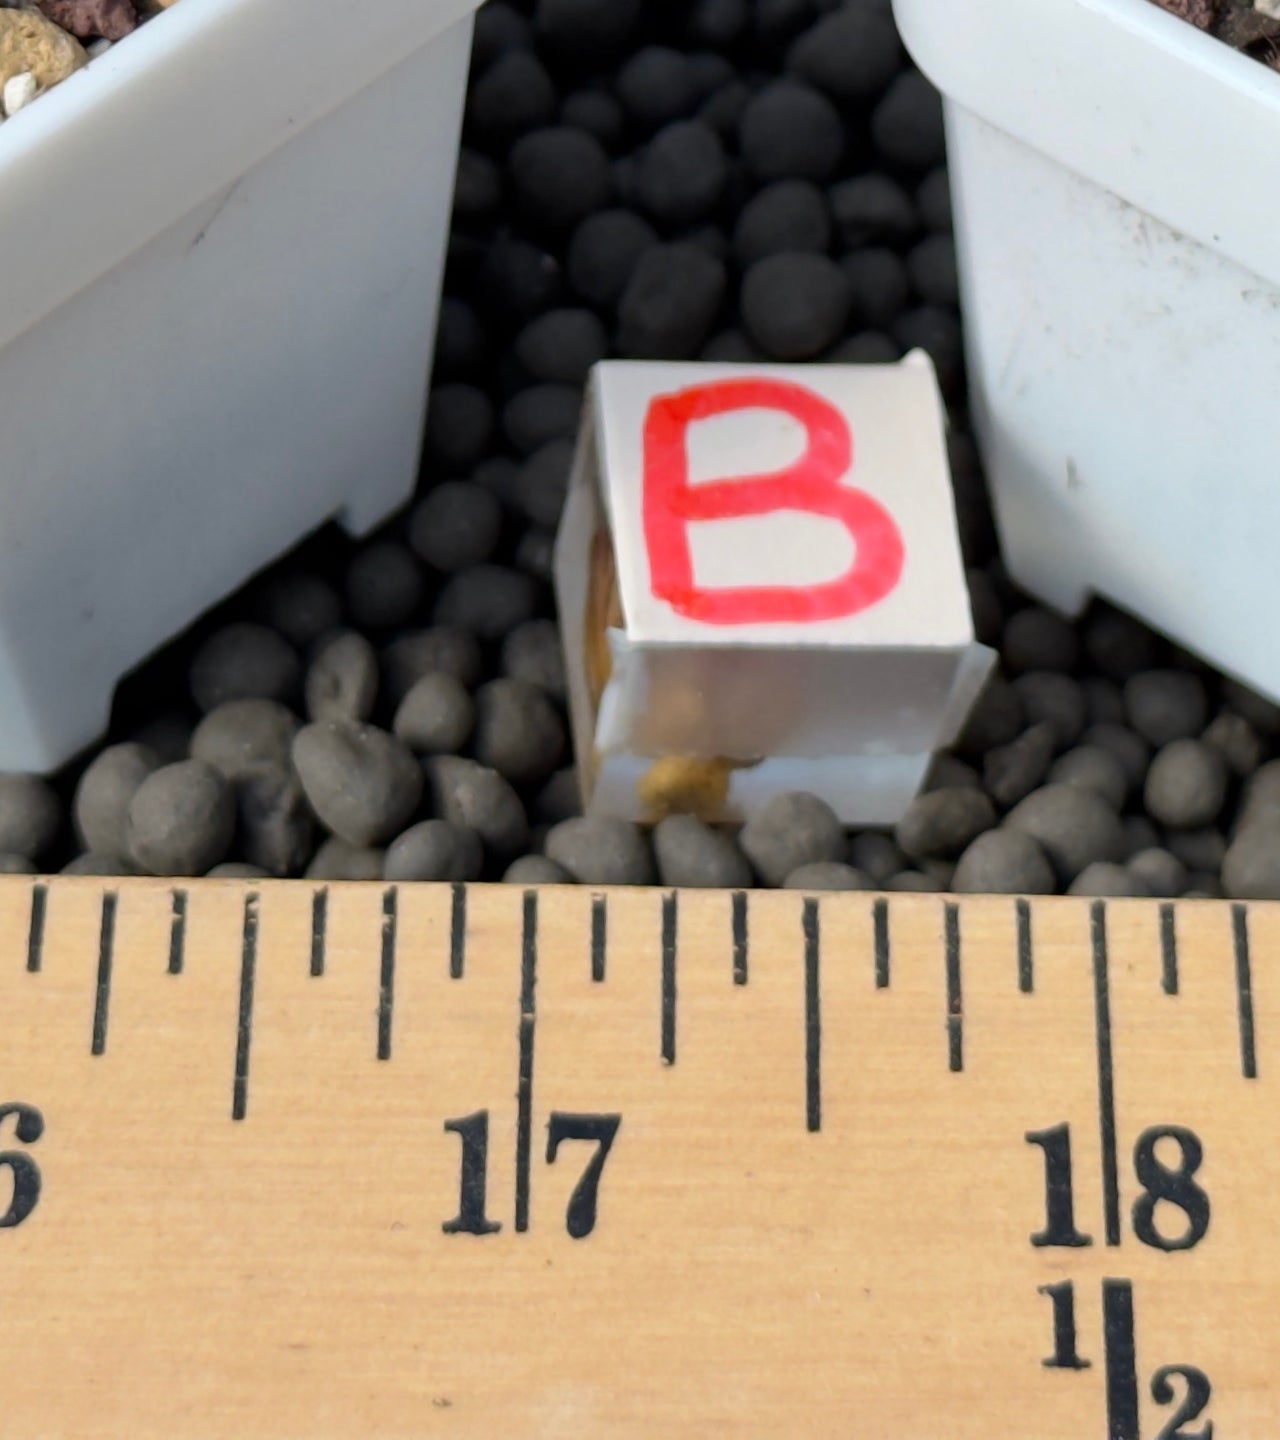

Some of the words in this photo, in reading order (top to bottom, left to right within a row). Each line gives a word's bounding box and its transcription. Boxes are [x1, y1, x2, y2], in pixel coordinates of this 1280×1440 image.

[640, 375, 908, 629] B
[441, 1108, 624, 1240] 17
[1024, 1121, 1212, 1254] 18
